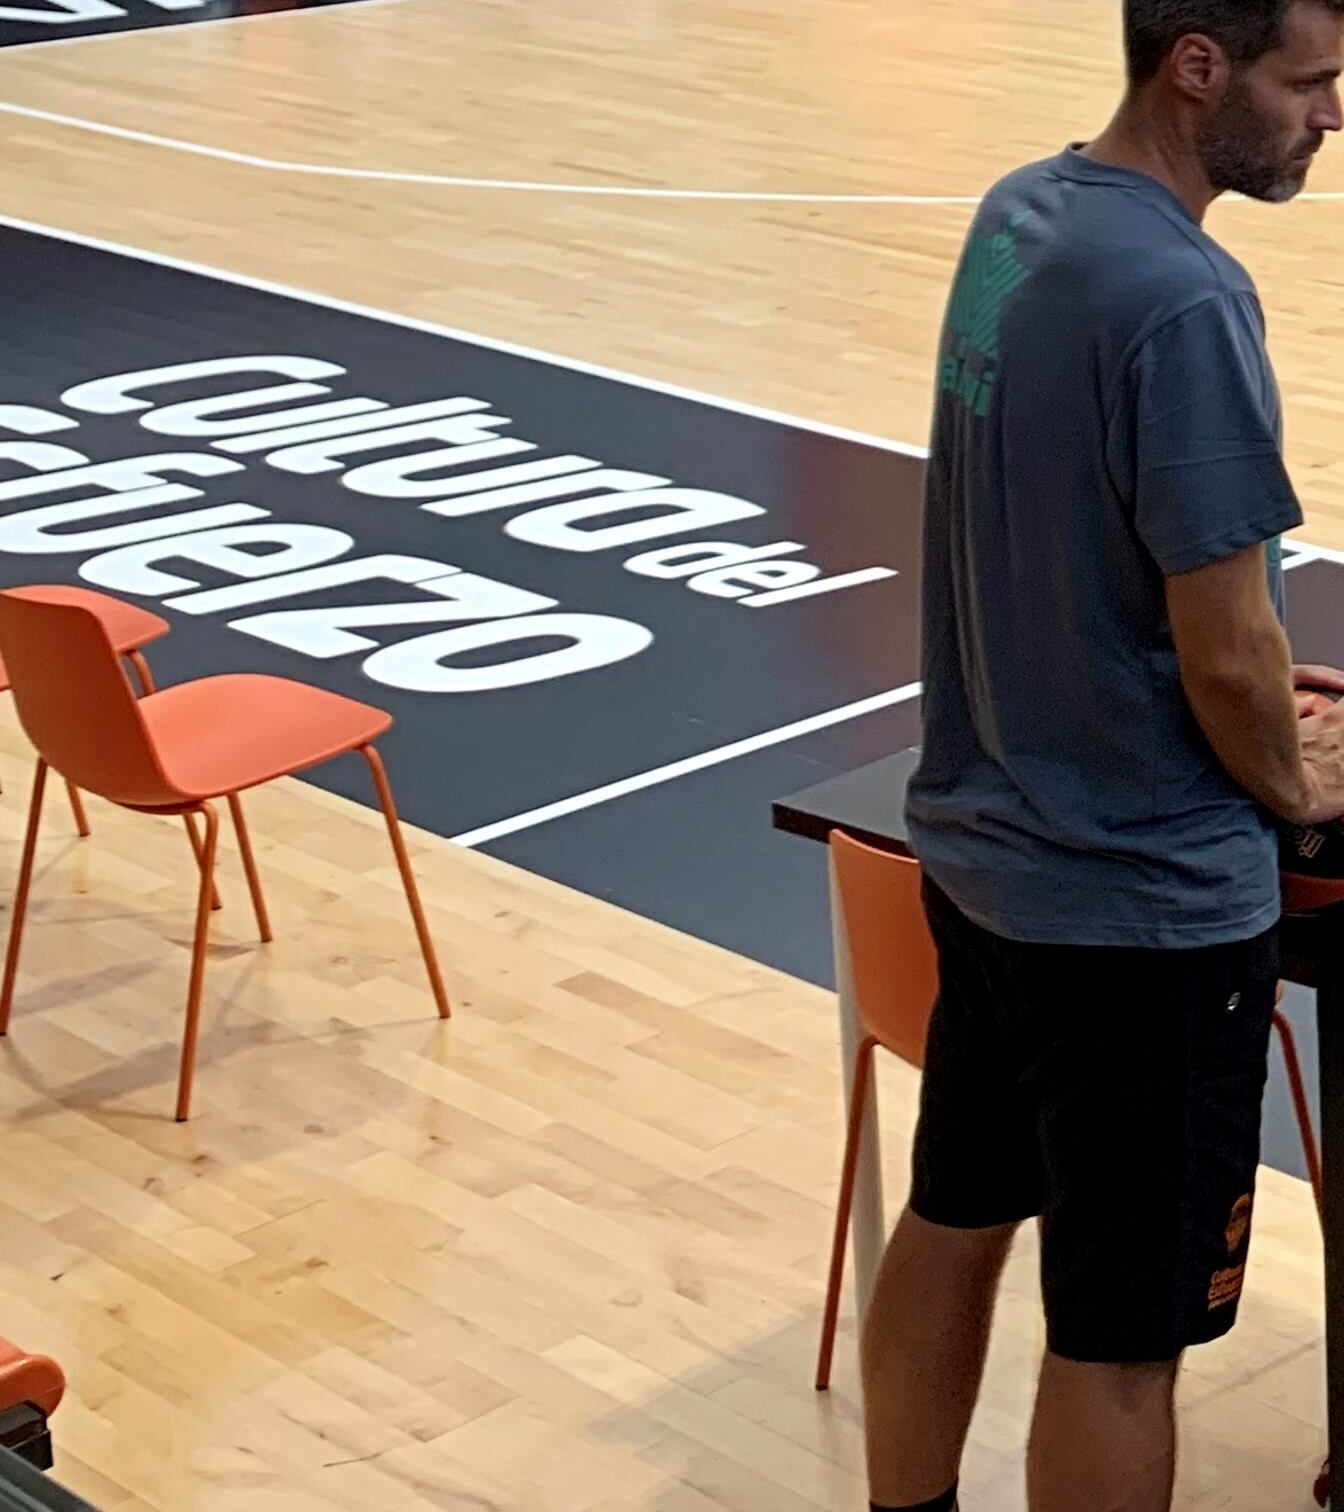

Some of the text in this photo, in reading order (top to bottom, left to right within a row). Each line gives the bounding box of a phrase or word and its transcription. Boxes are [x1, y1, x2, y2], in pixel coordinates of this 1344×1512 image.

[0, 403, 654, 694] fuerzo
[60, 355, 899, 609] Cultura del
